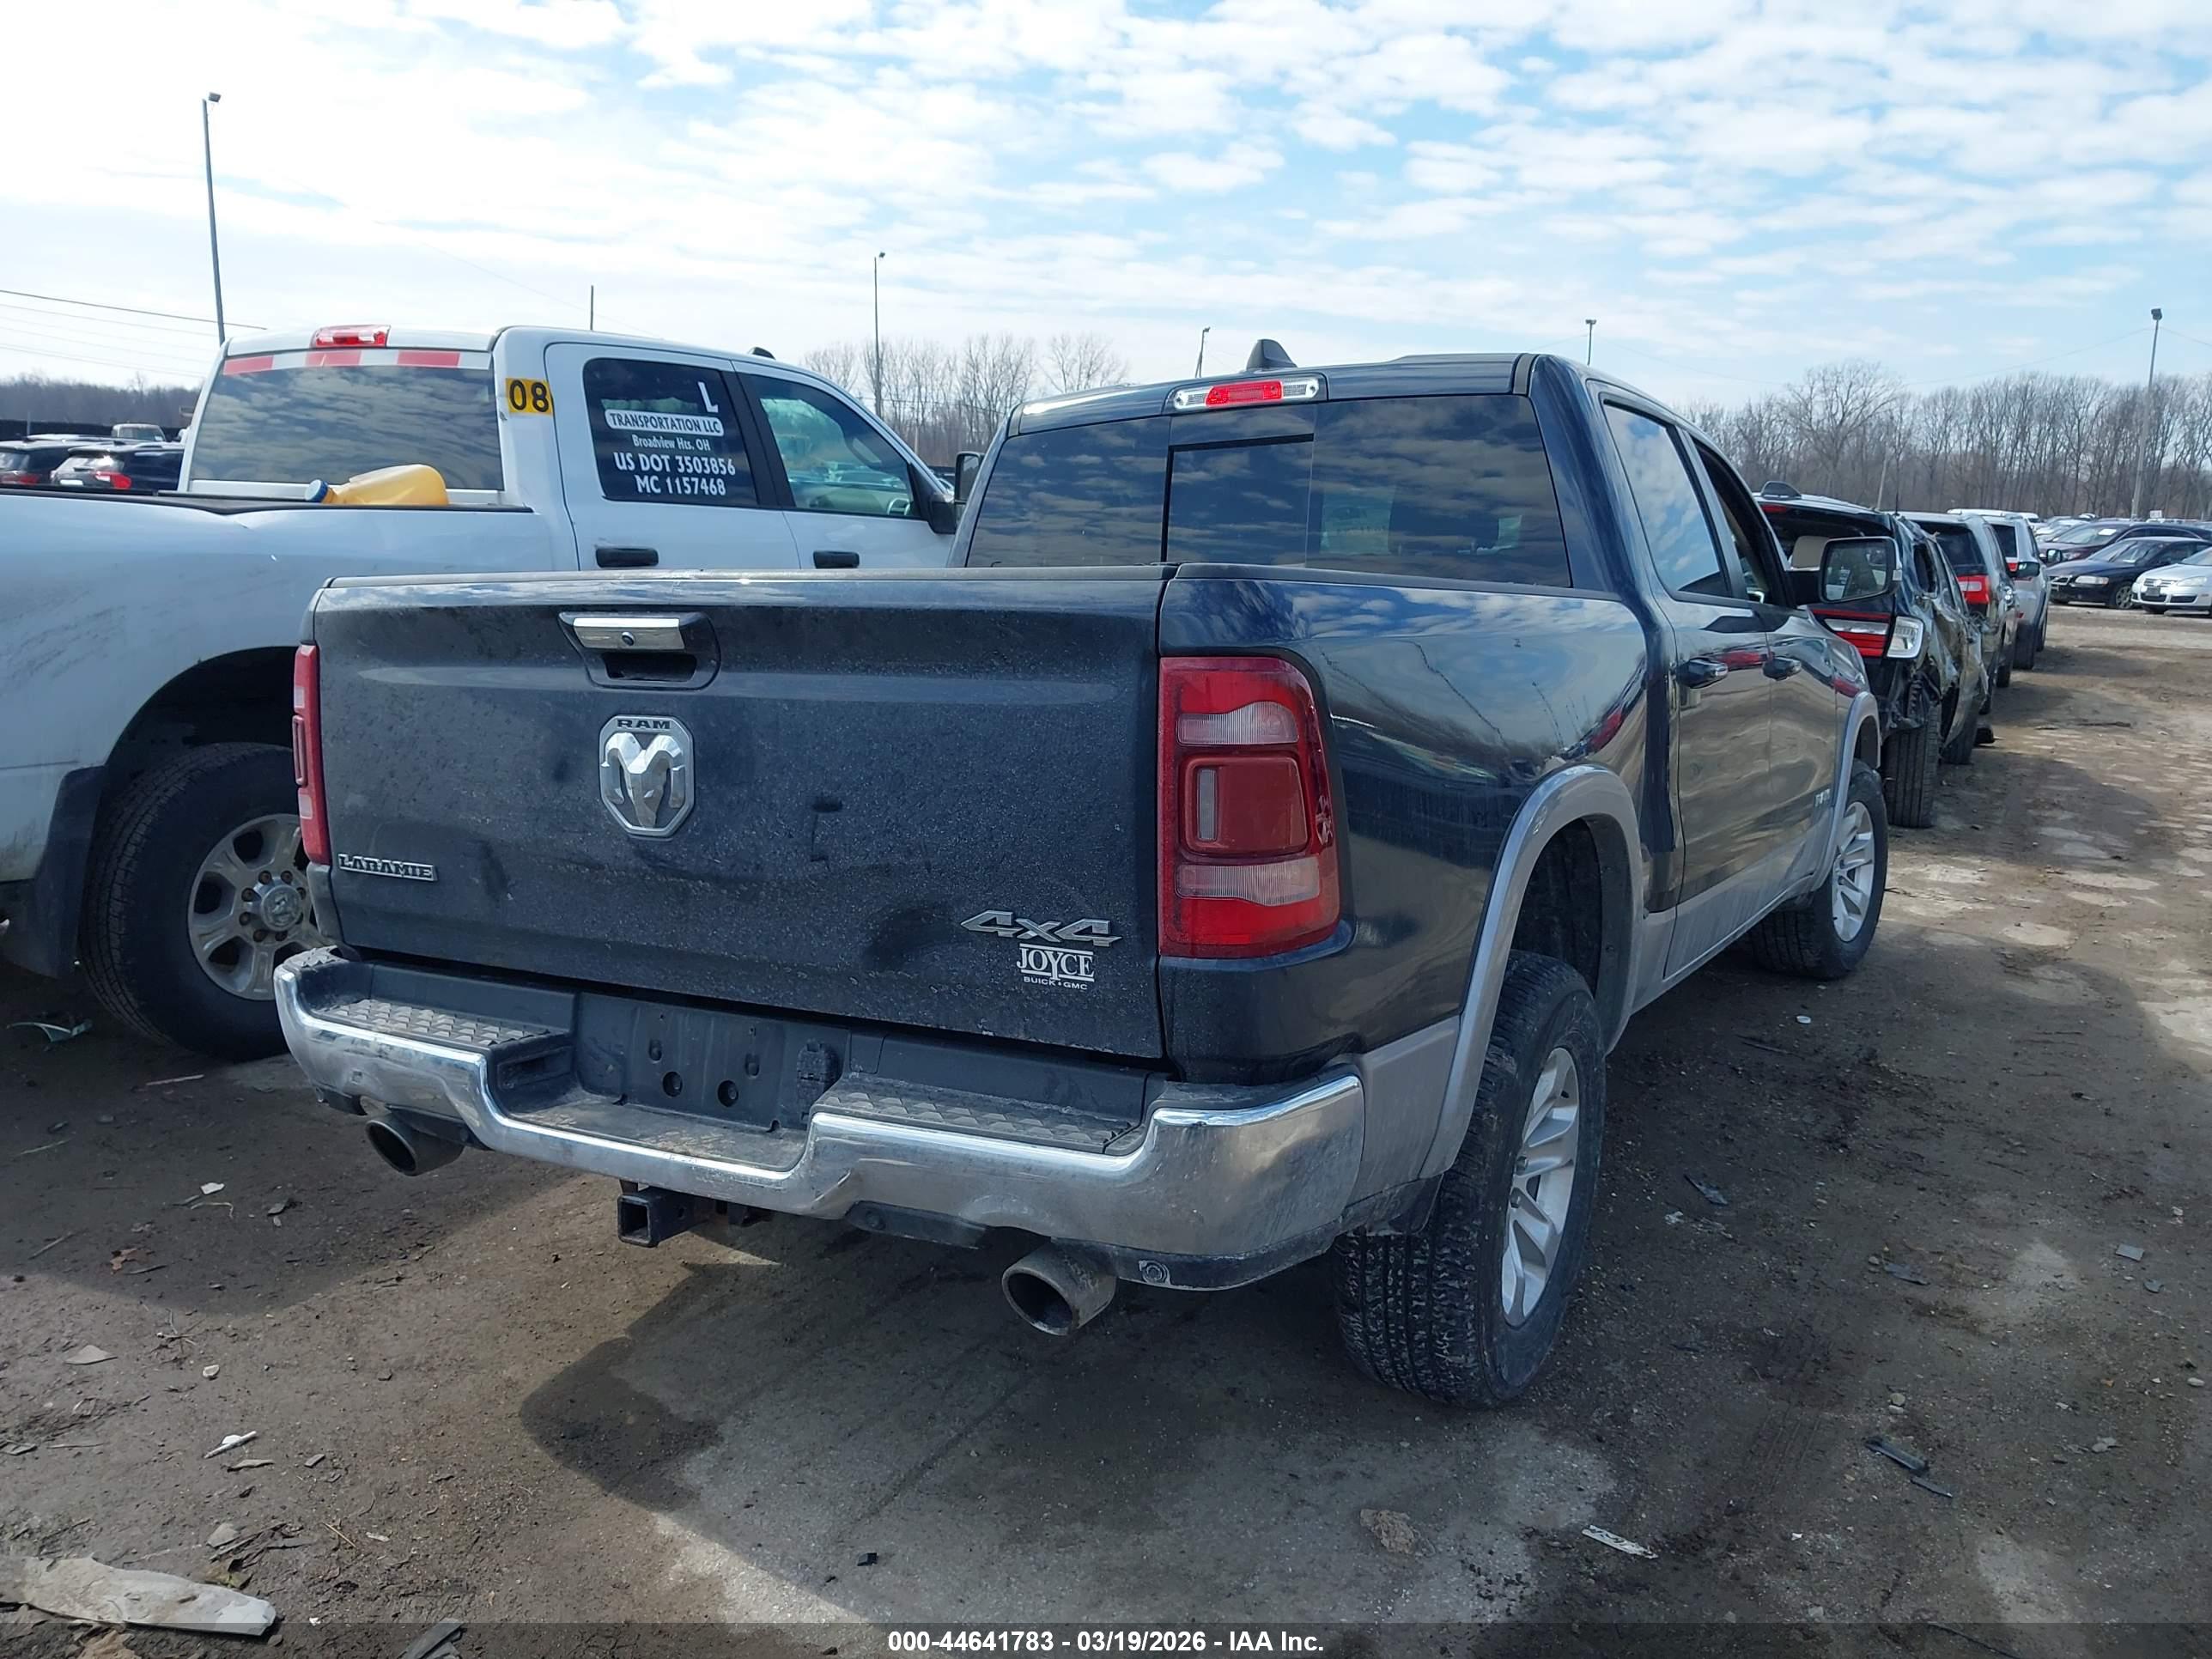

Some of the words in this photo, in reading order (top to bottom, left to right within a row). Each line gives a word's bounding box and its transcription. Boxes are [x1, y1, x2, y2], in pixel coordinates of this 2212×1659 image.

[509, 380, 549, 412] 08
[697, 381, 719, 413] L
[610, 413, 702, 433] TRANSPORTATION
[702, 420, 721, 434] LLC
[632, 434, 675, 449] Broadview
[696, 439, 711, 451] OH
[613, 452, 635, 471] US
[638, 453, 672, 472] DOT
[675, 455, 736, 476] 3503856
[635, 474, 662, 493] MC
[665, 477, 726, 495] 1157468
[617, 720, 671, 730] RAM
[338, 854, 436, 881] LARAMIE
[1016, 947, 1095, 981] JOYCE
[1023, 975, 1056, 987] BUICK
[1063, 981, 1088, 990] GMC
